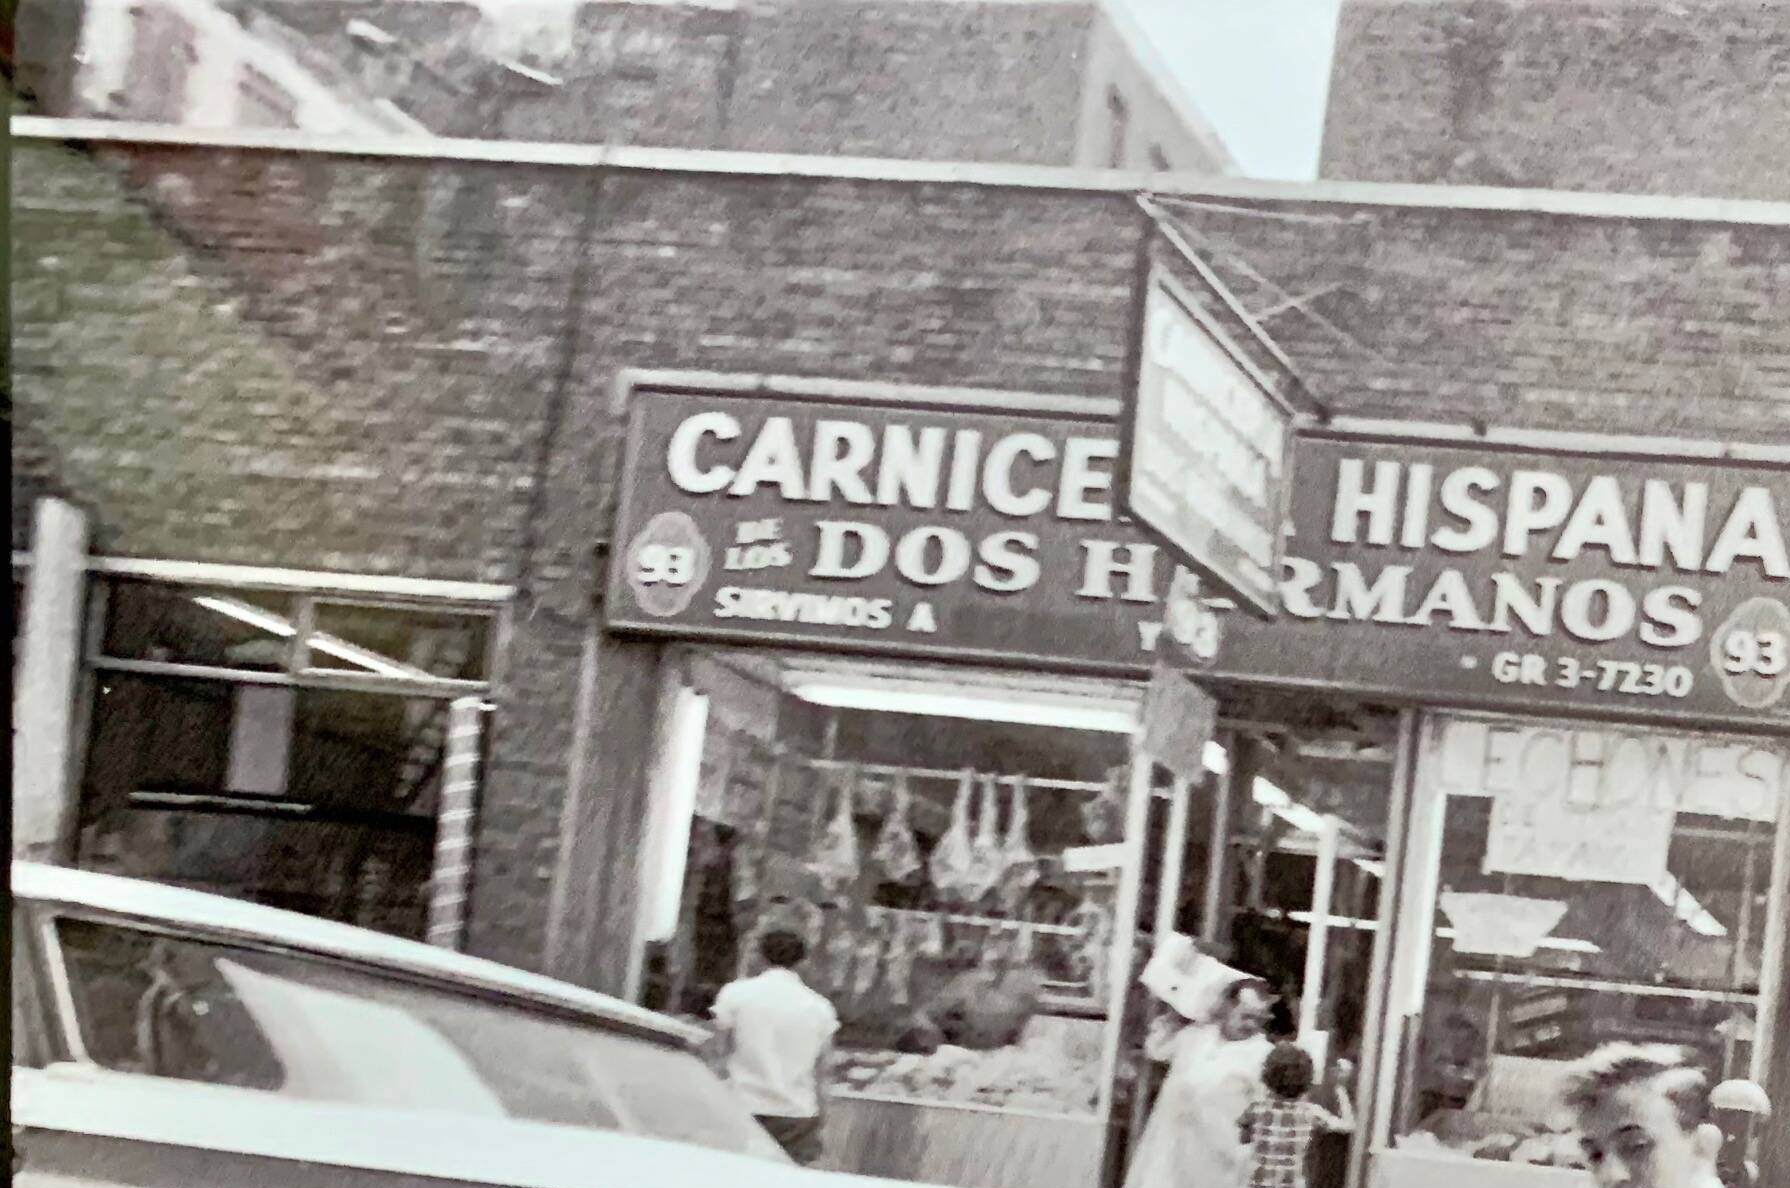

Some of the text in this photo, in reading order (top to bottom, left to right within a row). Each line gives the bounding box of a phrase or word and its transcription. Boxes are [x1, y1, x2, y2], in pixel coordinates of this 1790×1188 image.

[667, 411, 1124, 522] CARNICE
[808, 519, 1702, 647] DOS HRMANOS
[906, 602, 938, 633] A
[1492, 653, 1693, 699] GR 3-7230
[1724, 632, 1789, 677] 93
